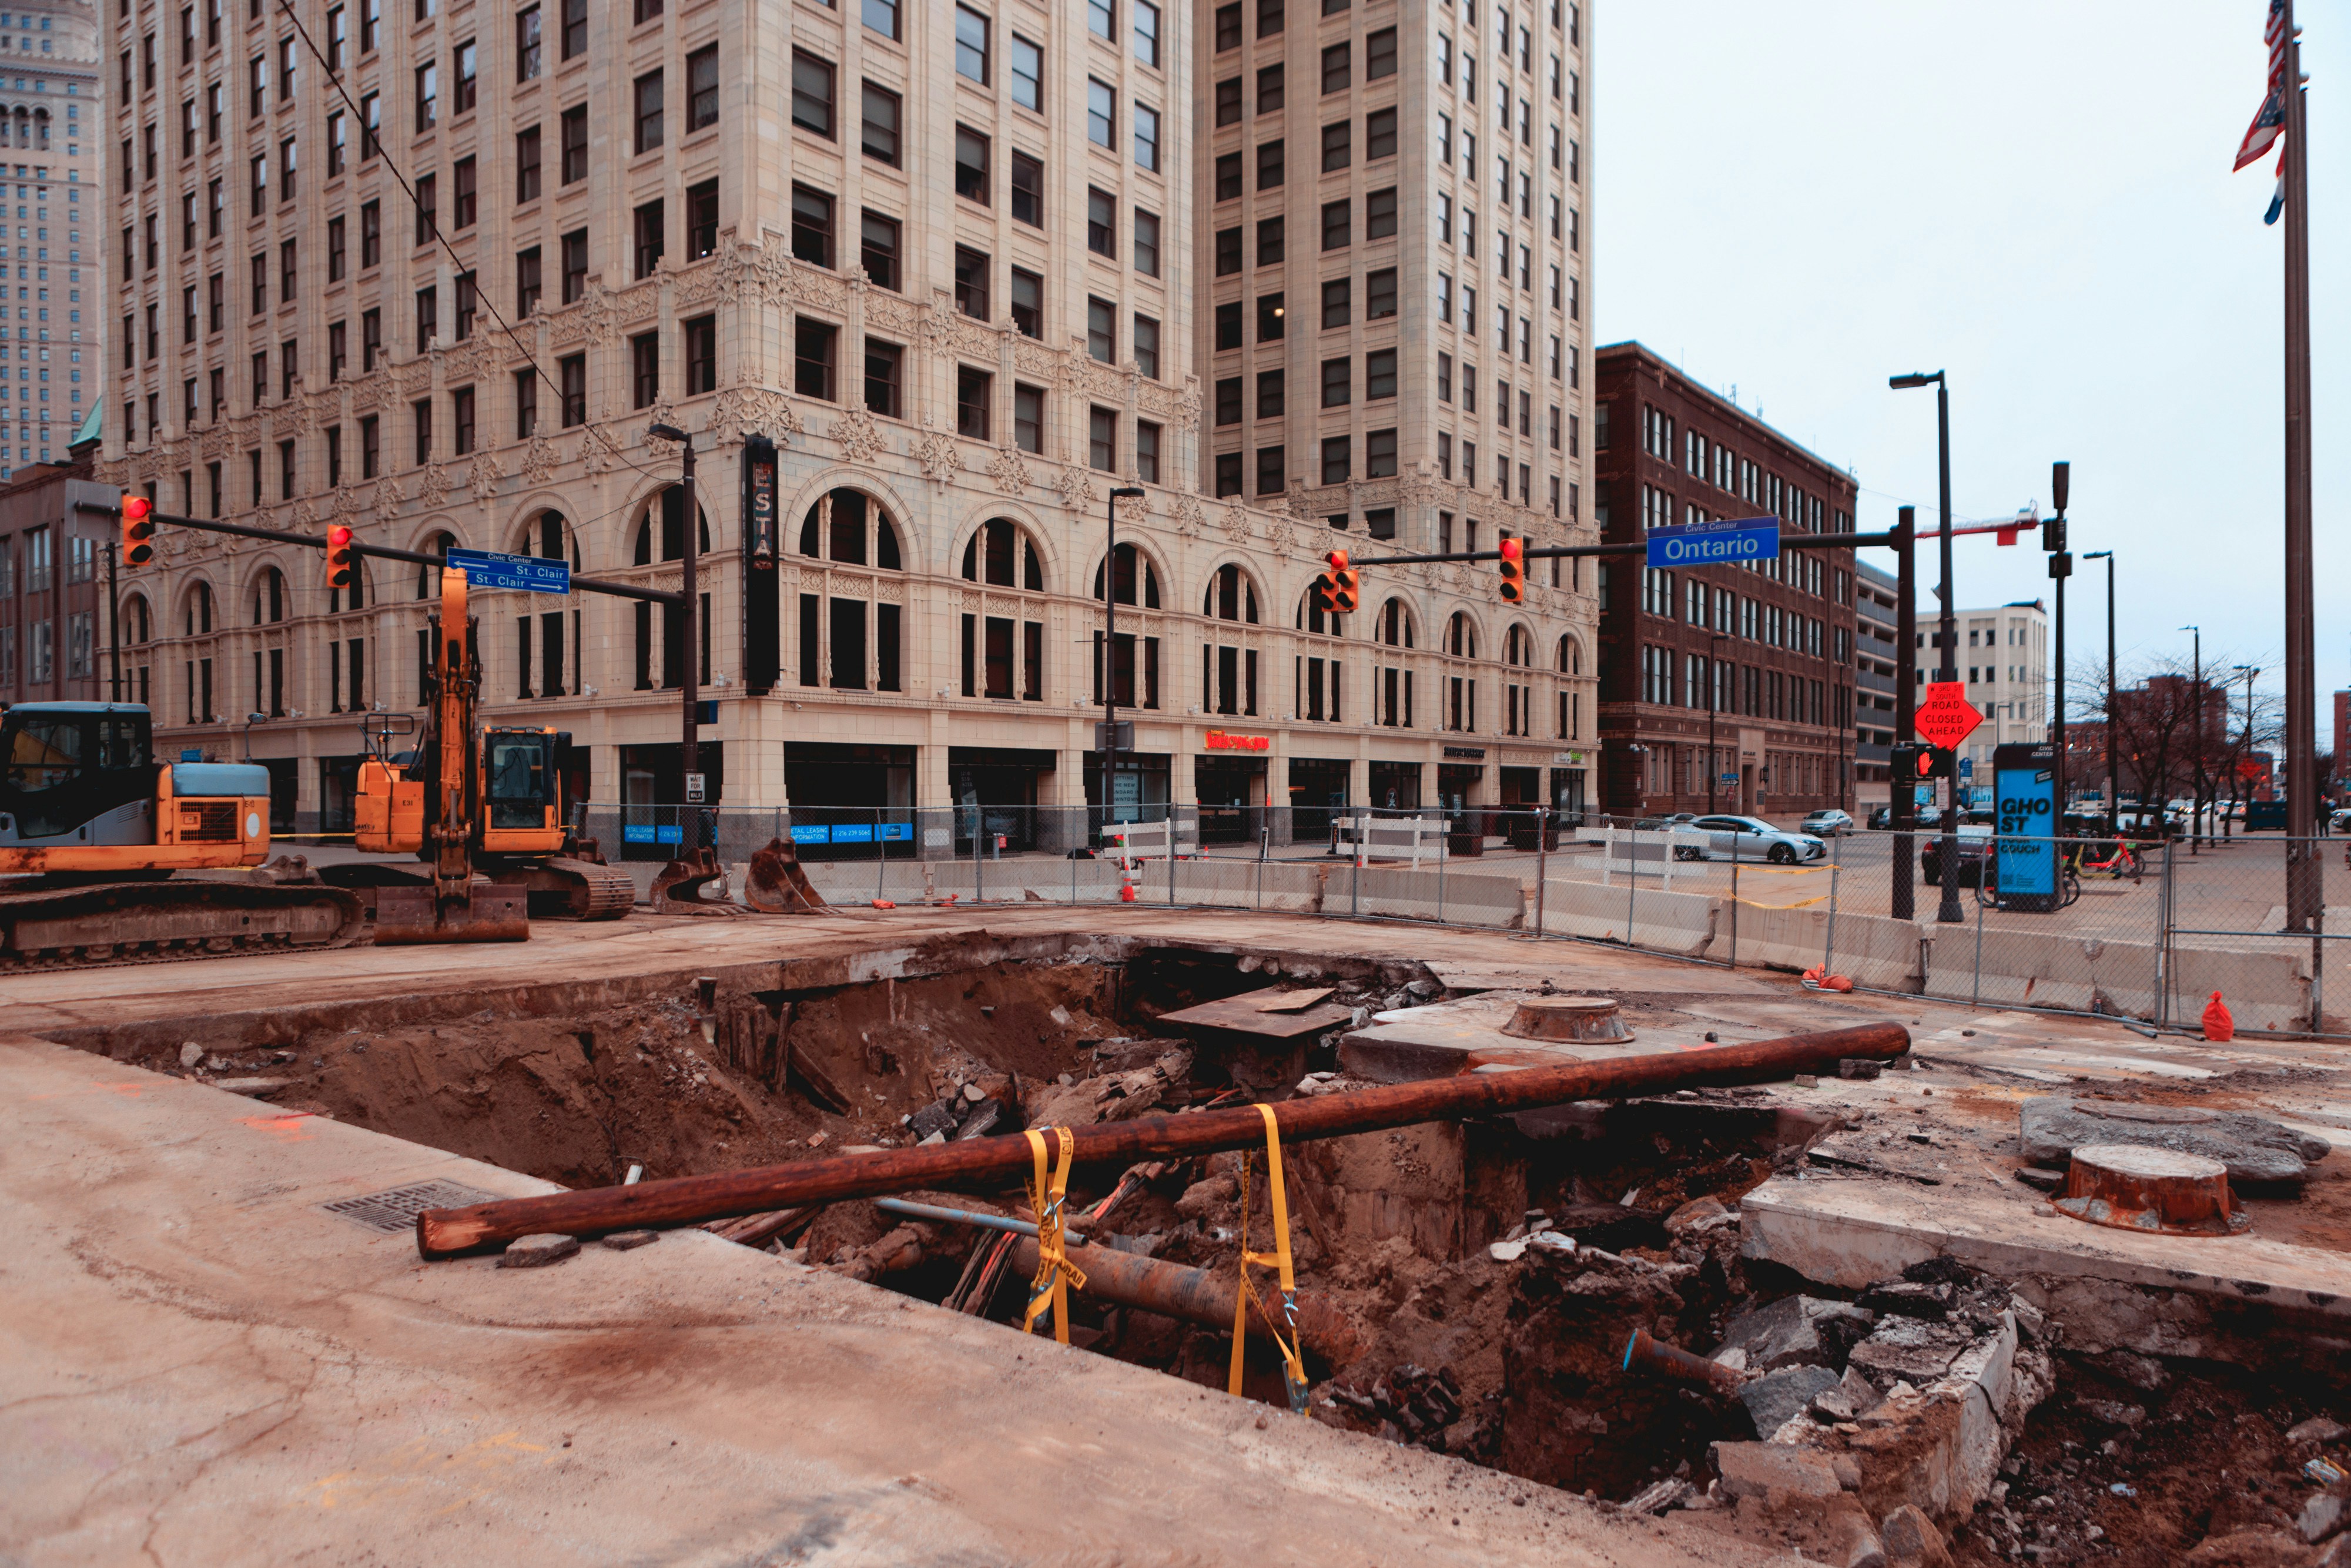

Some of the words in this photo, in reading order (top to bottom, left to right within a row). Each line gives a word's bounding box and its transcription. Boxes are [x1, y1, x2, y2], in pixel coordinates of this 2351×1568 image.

[1685, 523, 1706, 533] Civic
[1709, 521, 1737, 530] Center
[1665, 534, 1759, 559] Ontario
[488, 553, 505, 561] Civic
[508, 555, 532, 564] Center
[517, 565, 532, 575] St.
[537, 568, 564, 579] Clair
[476, 574, 492, 584] St.
[498, 577, 525, 587] Clair
[1932, 701, 1960, 710] ROAD
[1925, 715, 1964, 723] CLOSED
[1928, 726, 1964, 735] AHEAD
[2001, 798, 2051, 815] GHO
[2001, 815, 2030, 833] ST
[2001, 844, 2041, 854] COUCH
